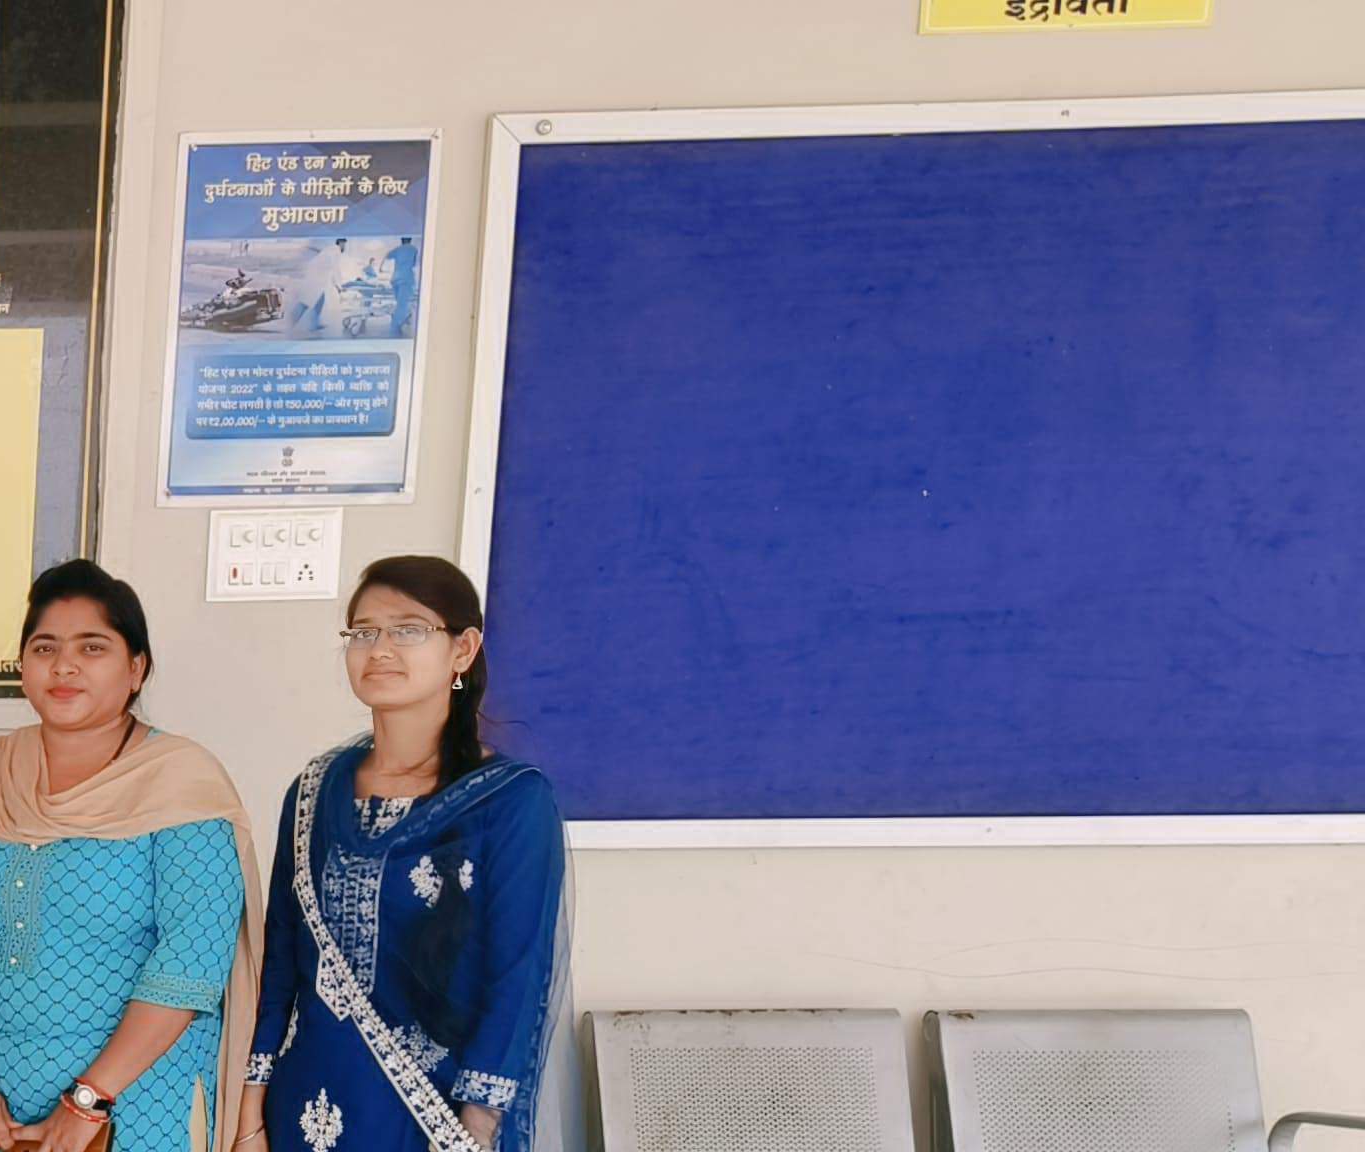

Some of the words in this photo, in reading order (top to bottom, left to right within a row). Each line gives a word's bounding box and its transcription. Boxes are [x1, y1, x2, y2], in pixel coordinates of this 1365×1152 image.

[246, 152, 272, 173] हिट
[277, 151, 300, 171] एंड
[303, 155, 328, 171] रन
[331, 150, 372, 171] मोटर
[204, 178, 276, 203] दुर्घटनाओं
[281, 179, 296, 197] के
[301, 176, 353, 200] पीड़ितों
[358, 177, 375, 196] के
[378, 175, 410, 197] लिए
[261, 205, 349, 232] मुआवजा
